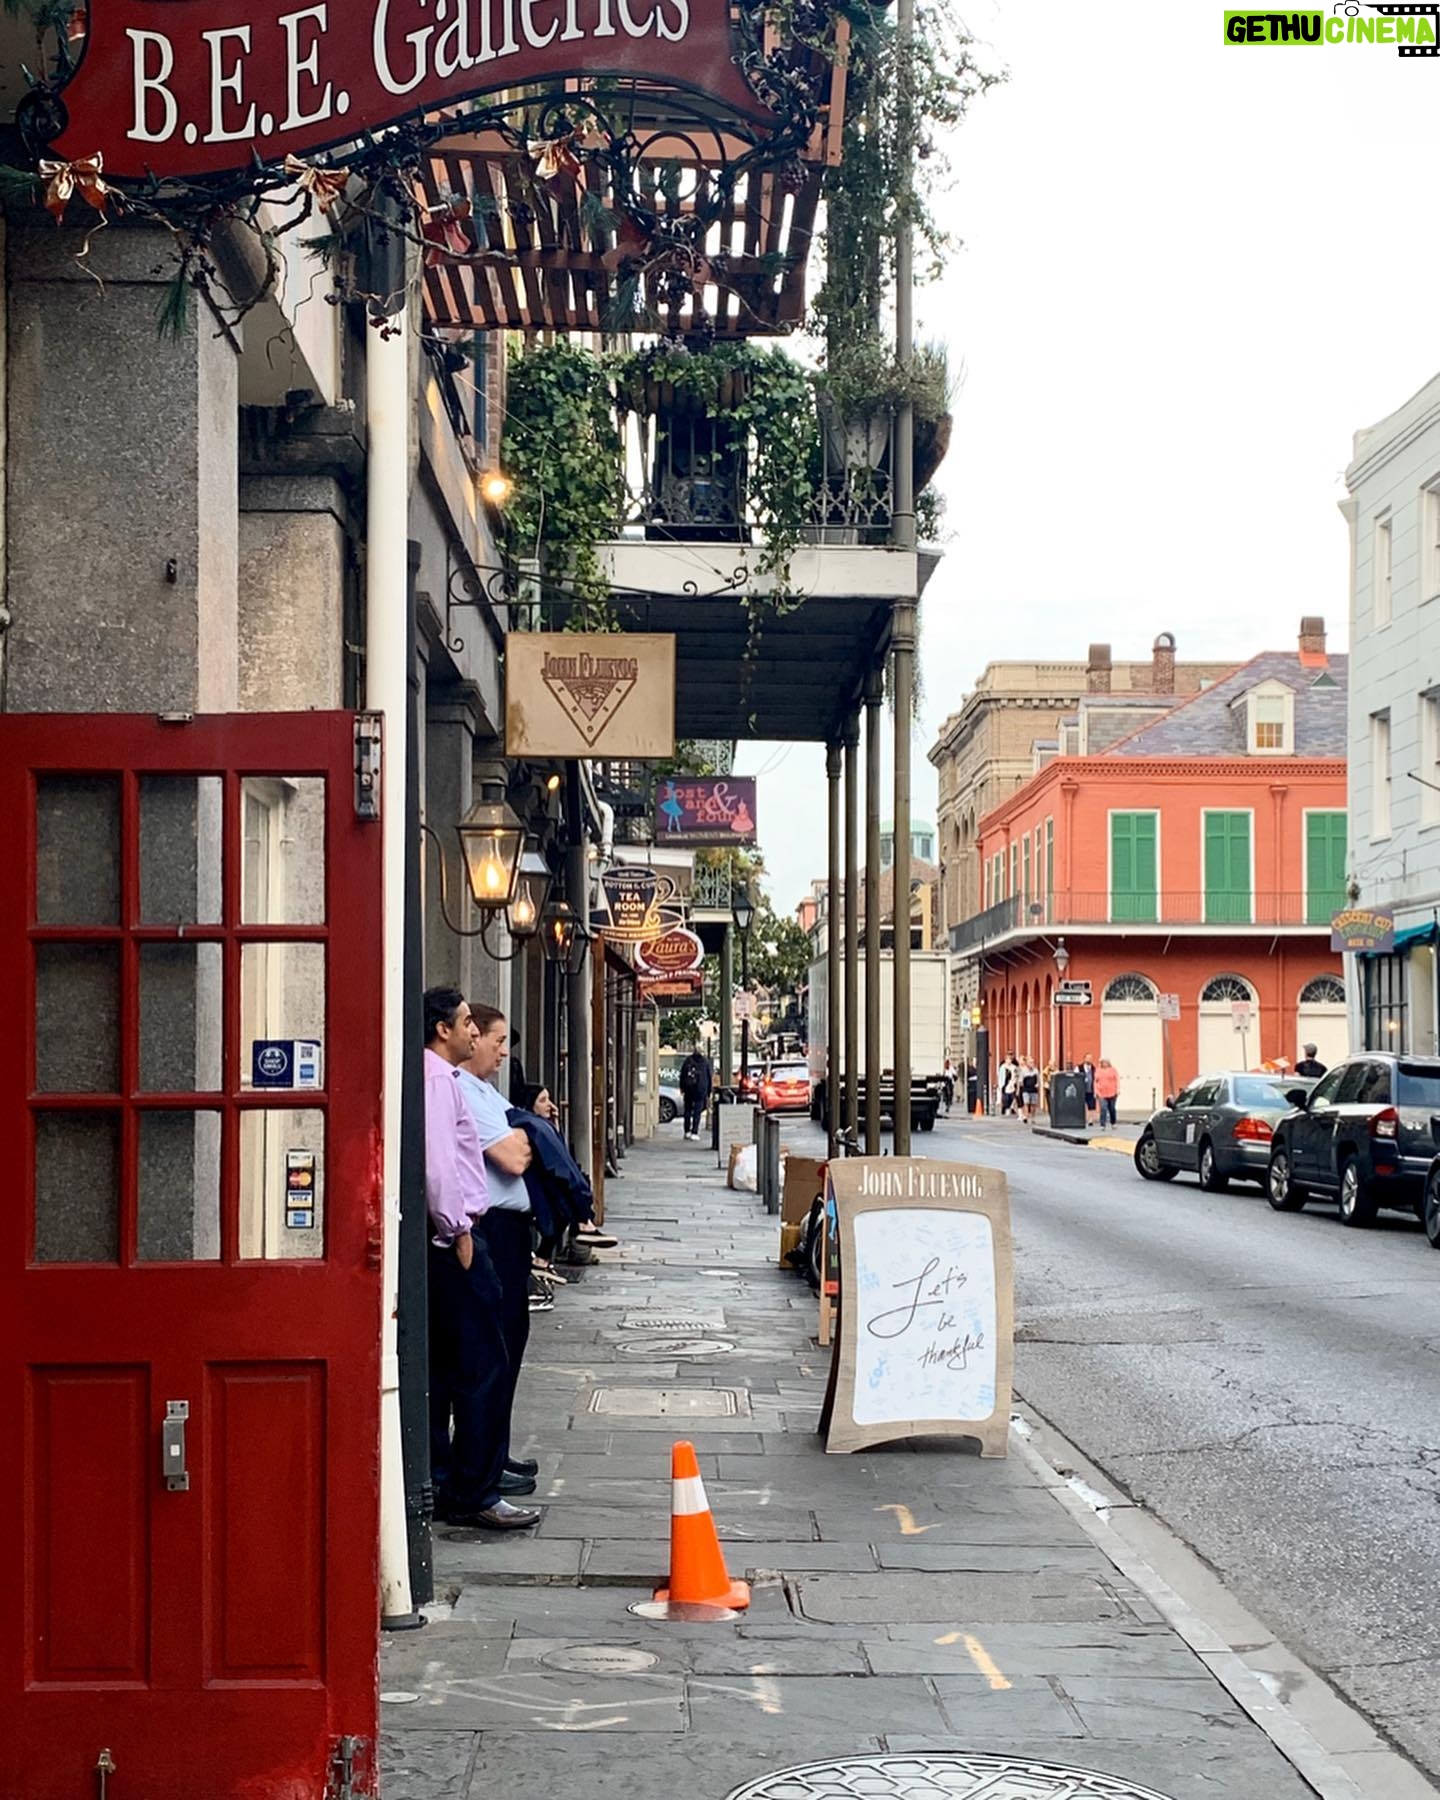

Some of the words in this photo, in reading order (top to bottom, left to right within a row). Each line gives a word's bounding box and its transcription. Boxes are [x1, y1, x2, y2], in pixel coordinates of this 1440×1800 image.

[126, 4, 350, 146] B.E.E.
[614, 902, 645, 911] ROOM
[619, 892, 640, 901] TEA
[640, 940, 697, 957] Laura's
[858, 1165, 902, 1196] JOHN
[867, 1257, 968, 1339] Let's
[937, 1313, 957, 1331] be
[917, 1333, 985, 1371] thankful
